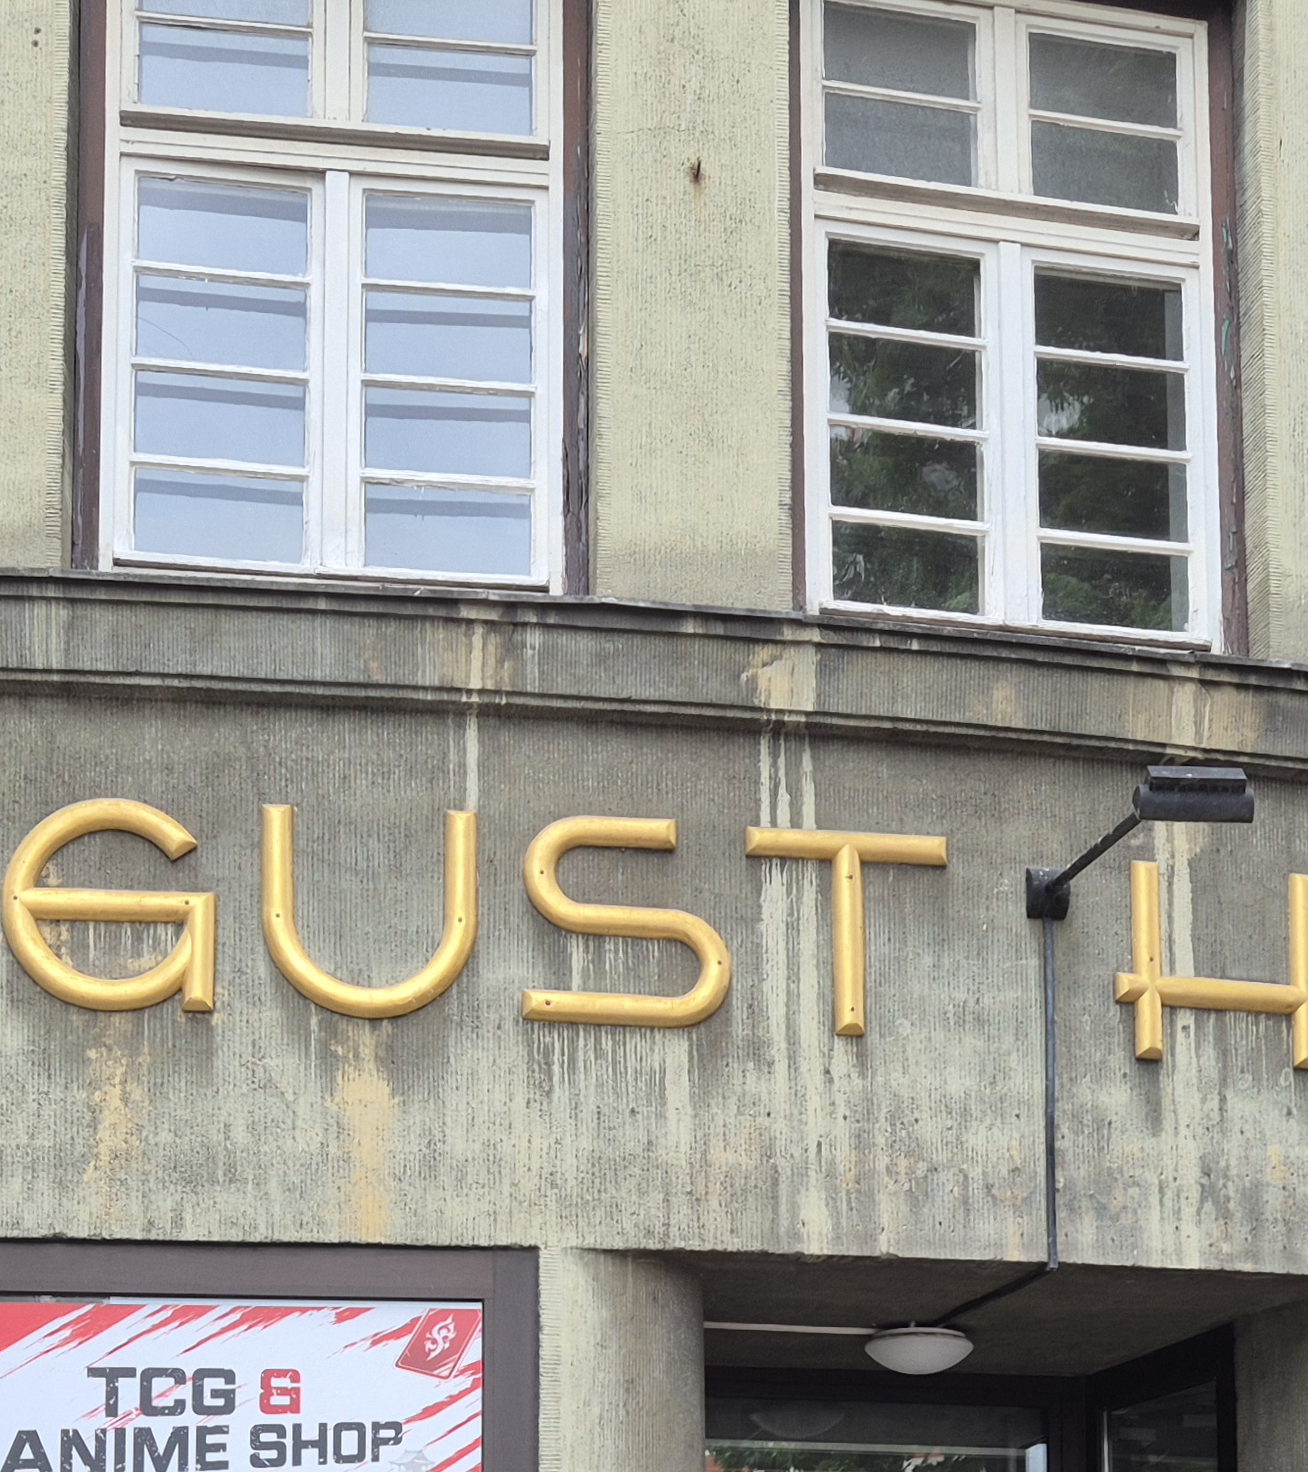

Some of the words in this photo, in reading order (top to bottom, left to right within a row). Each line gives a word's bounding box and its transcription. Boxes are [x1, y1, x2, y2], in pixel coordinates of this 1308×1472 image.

[87, 1366, 237, 1418] TCG
[259, 1368, 301, 1415] &
[249, 1421, 403, 1469] SHOP
